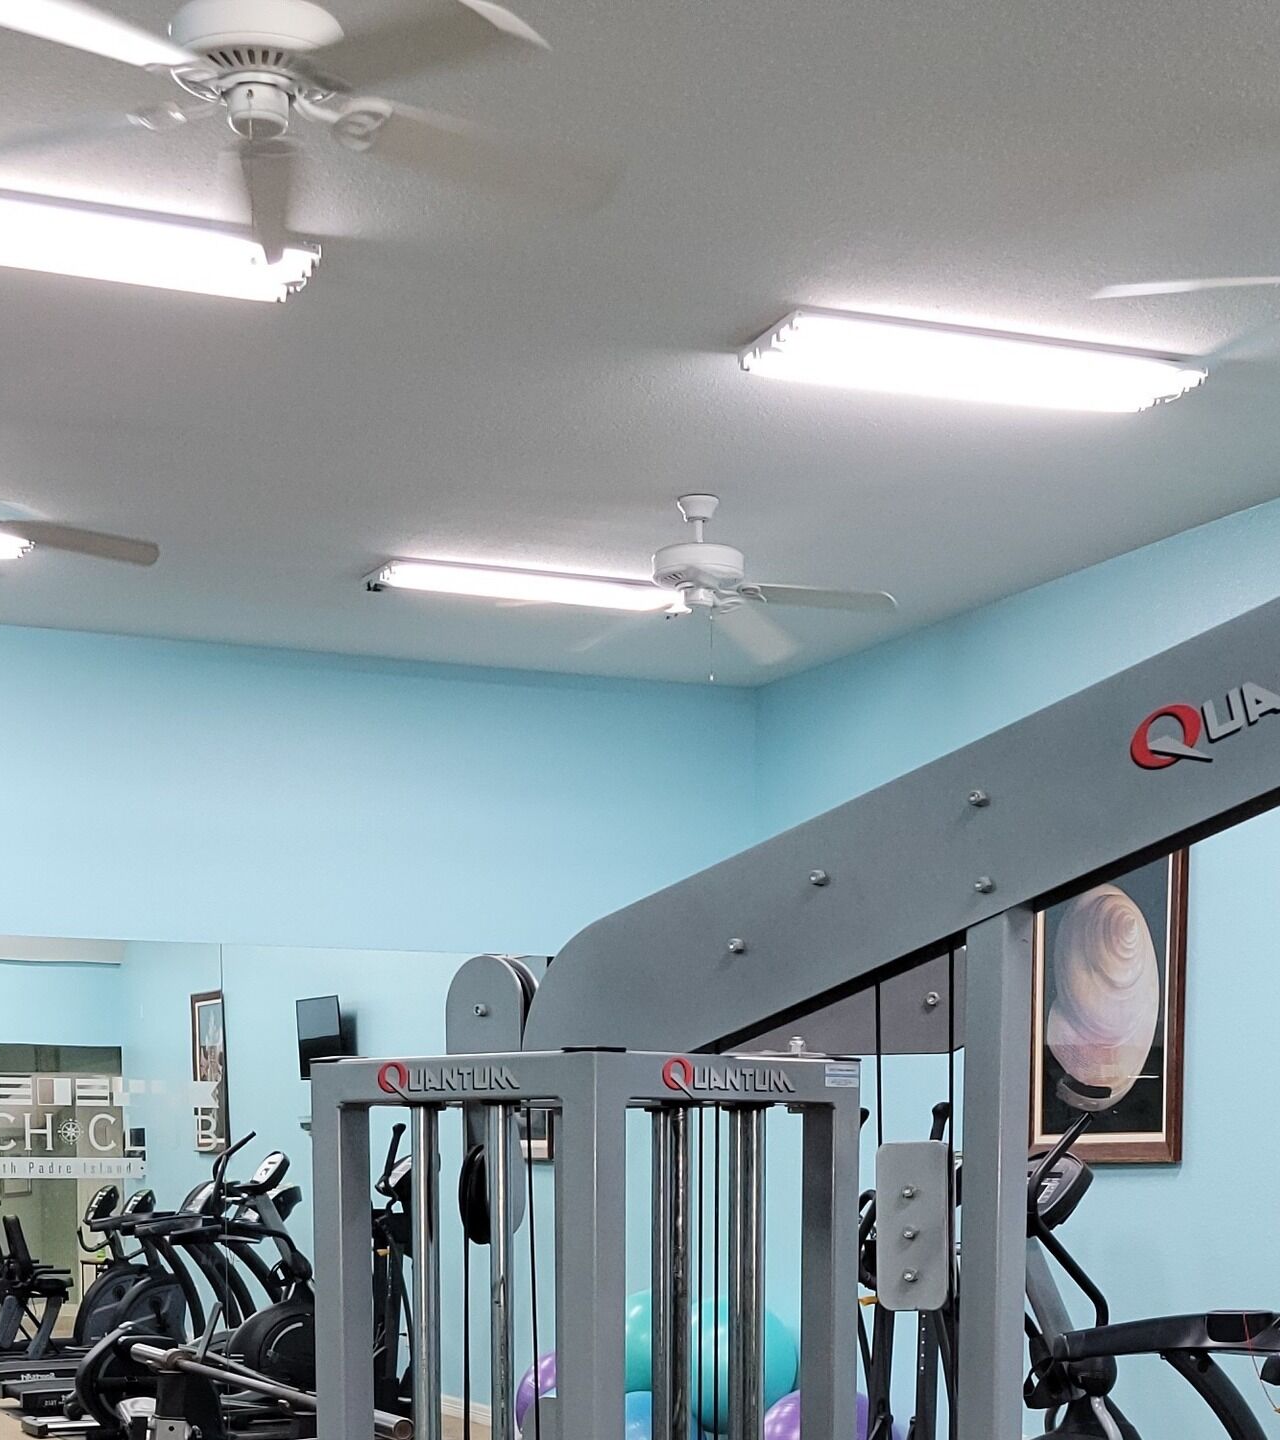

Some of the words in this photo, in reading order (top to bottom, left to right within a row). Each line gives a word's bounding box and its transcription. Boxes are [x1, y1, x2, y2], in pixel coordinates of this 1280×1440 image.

[377, 1061, 520, 1101] QUANTUM
[662, 1056, 796, 1100] QUANTUM
[88, 1112, 219, 1153] CLB
[28, 1161, 72, 1175] Padre
[83, 1162, 132, 1175] Island
